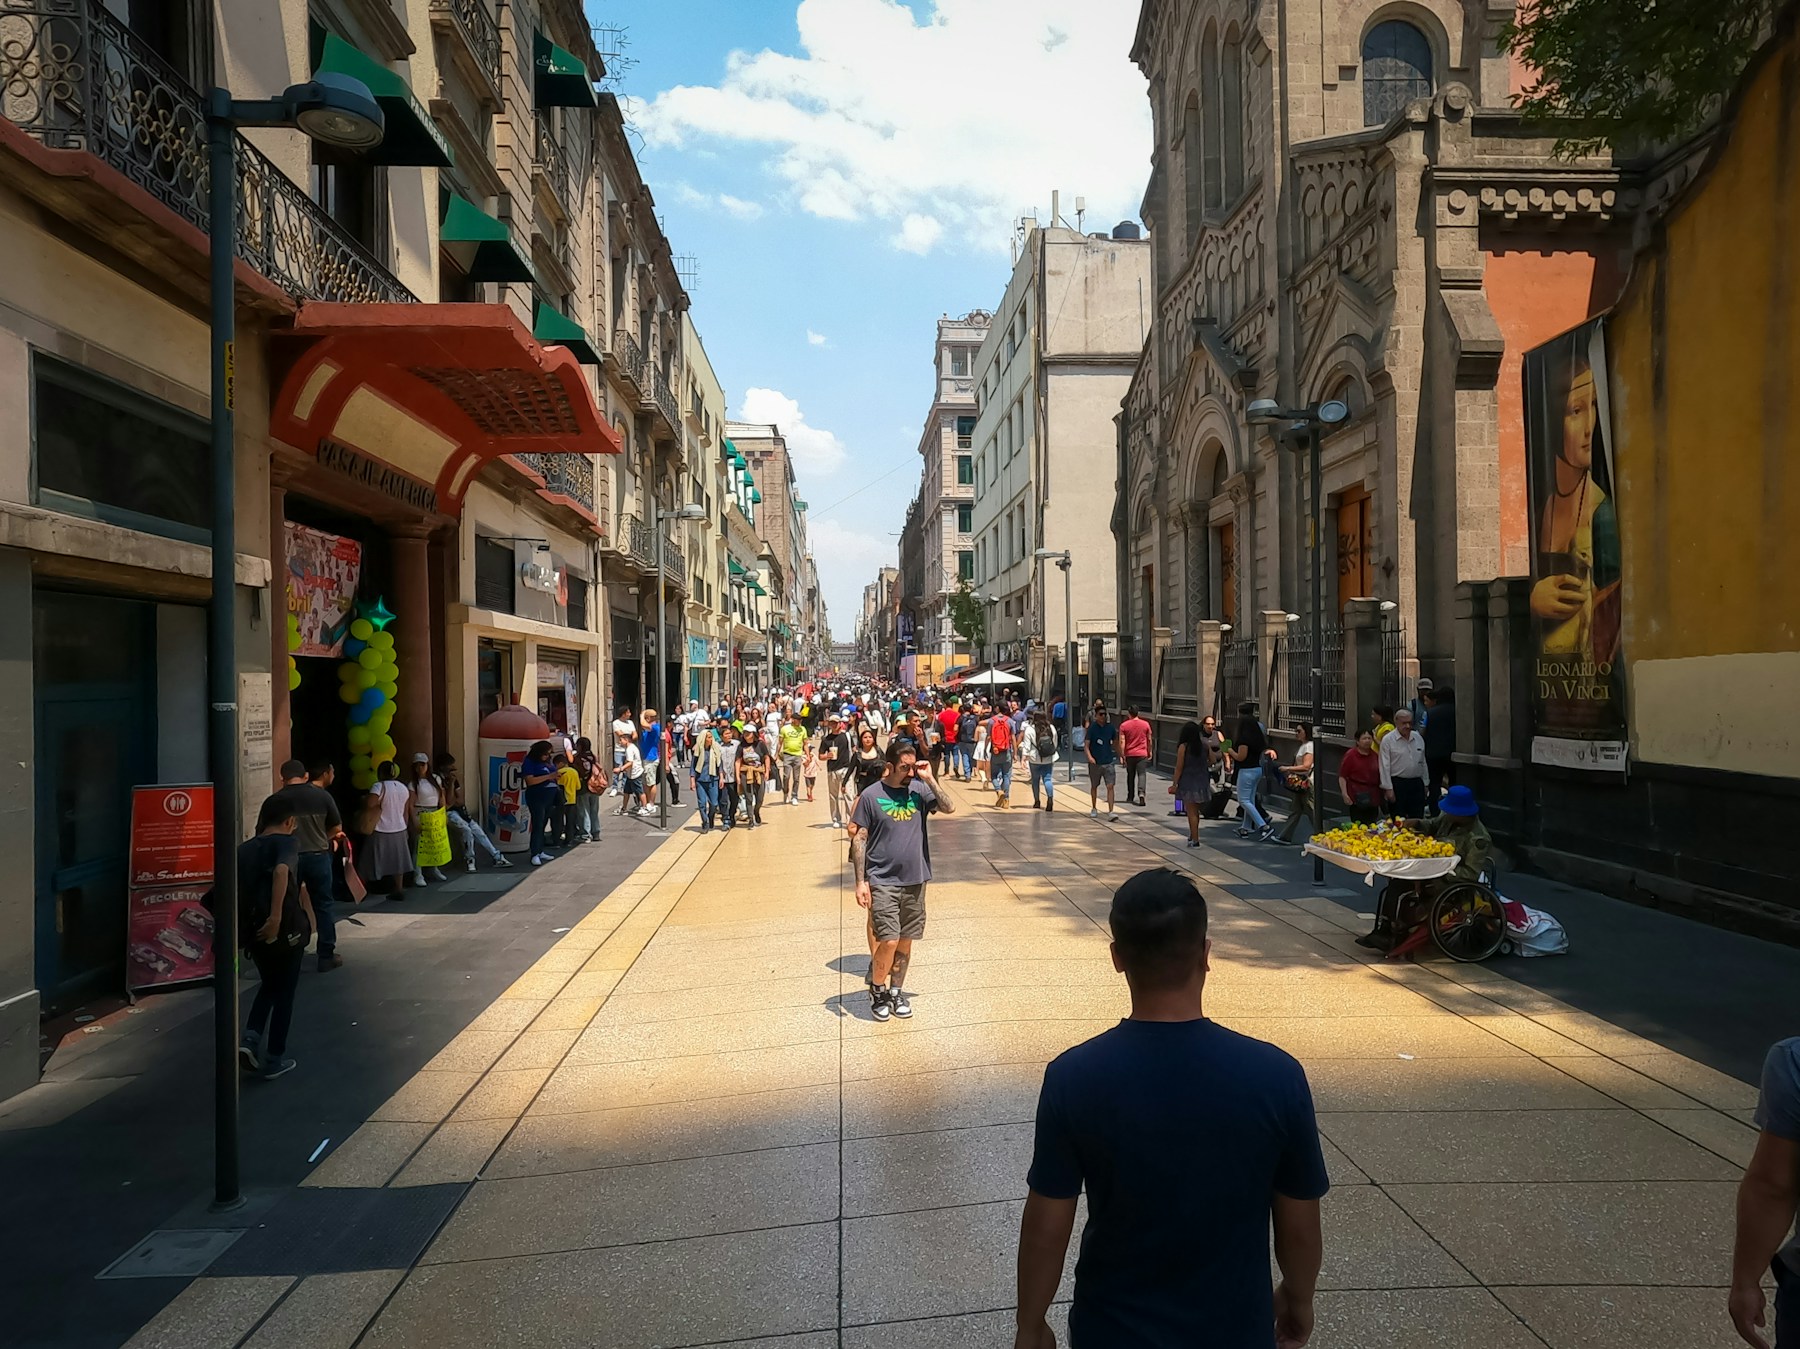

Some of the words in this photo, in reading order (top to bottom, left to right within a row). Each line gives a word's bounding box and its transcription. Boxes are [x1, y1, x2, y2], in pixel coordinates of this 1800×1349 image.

[317, 437, 376, 486] PASAJE
[498, 761, 526, 792] IC
[156, 869, 214, 880] Sanborns
